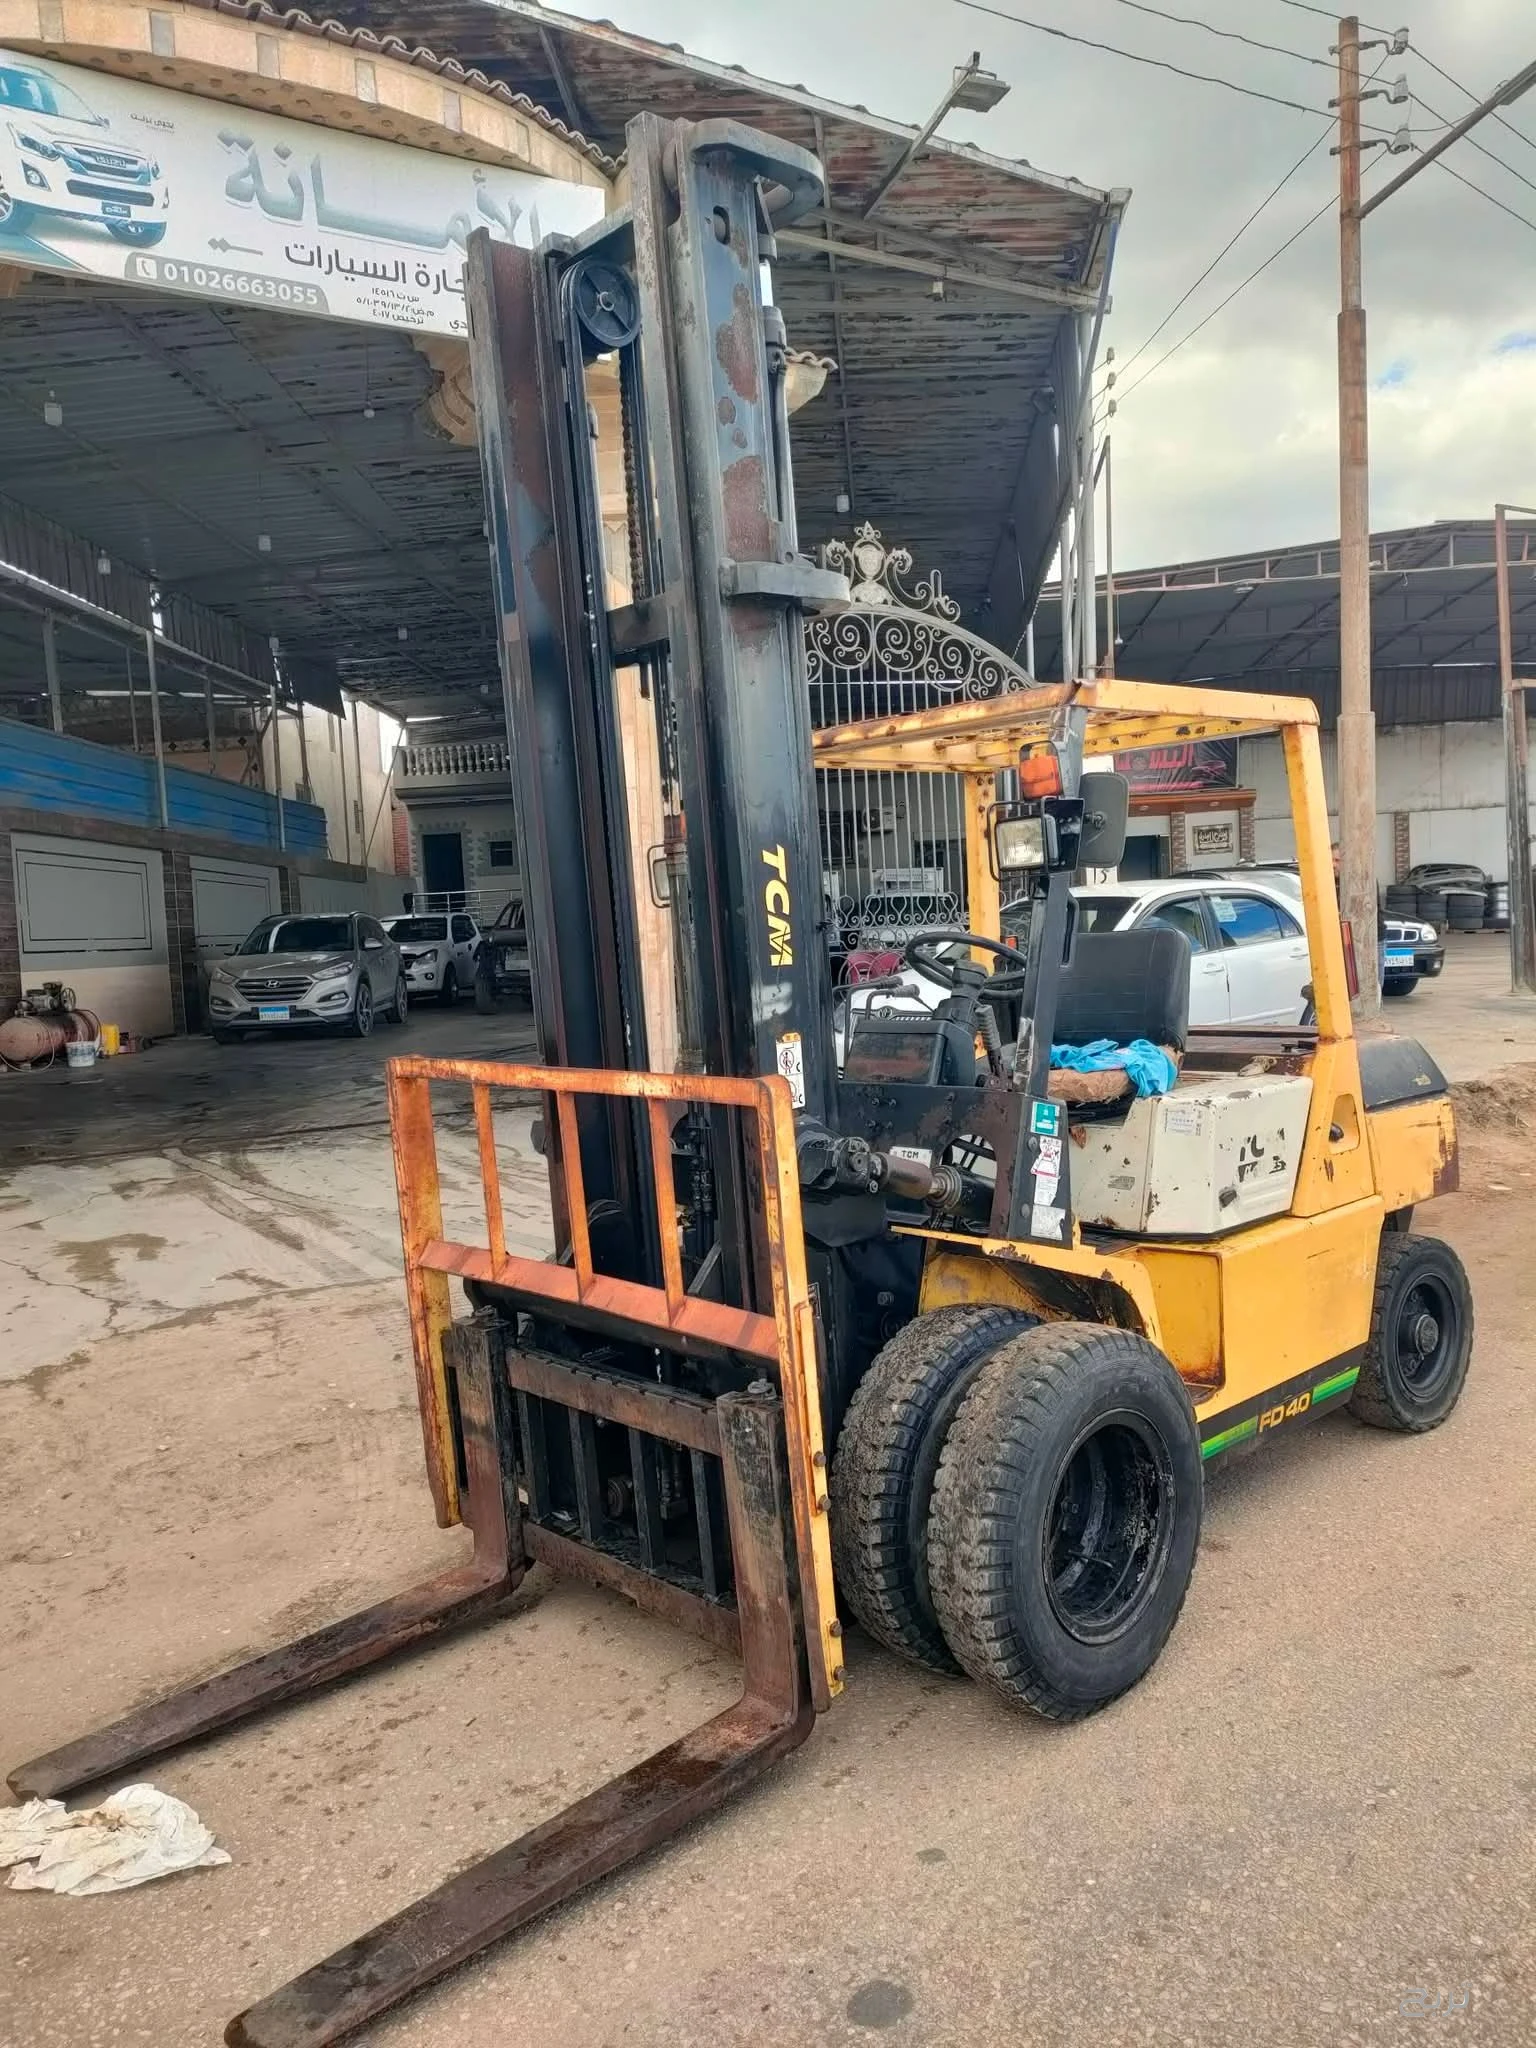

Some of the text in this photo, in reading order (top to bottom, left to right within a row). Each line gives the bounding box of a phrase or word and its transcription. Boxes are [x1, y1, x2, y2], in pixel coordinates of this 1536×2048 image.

[163, 262, 318, 306] 01026663055
[284, 244, 407, 284] السيارات
[392, 313, 424, 325] ترخيص
[762, 844, 793, 966] TCM
[901, 1150, 919, 1159] TCM
